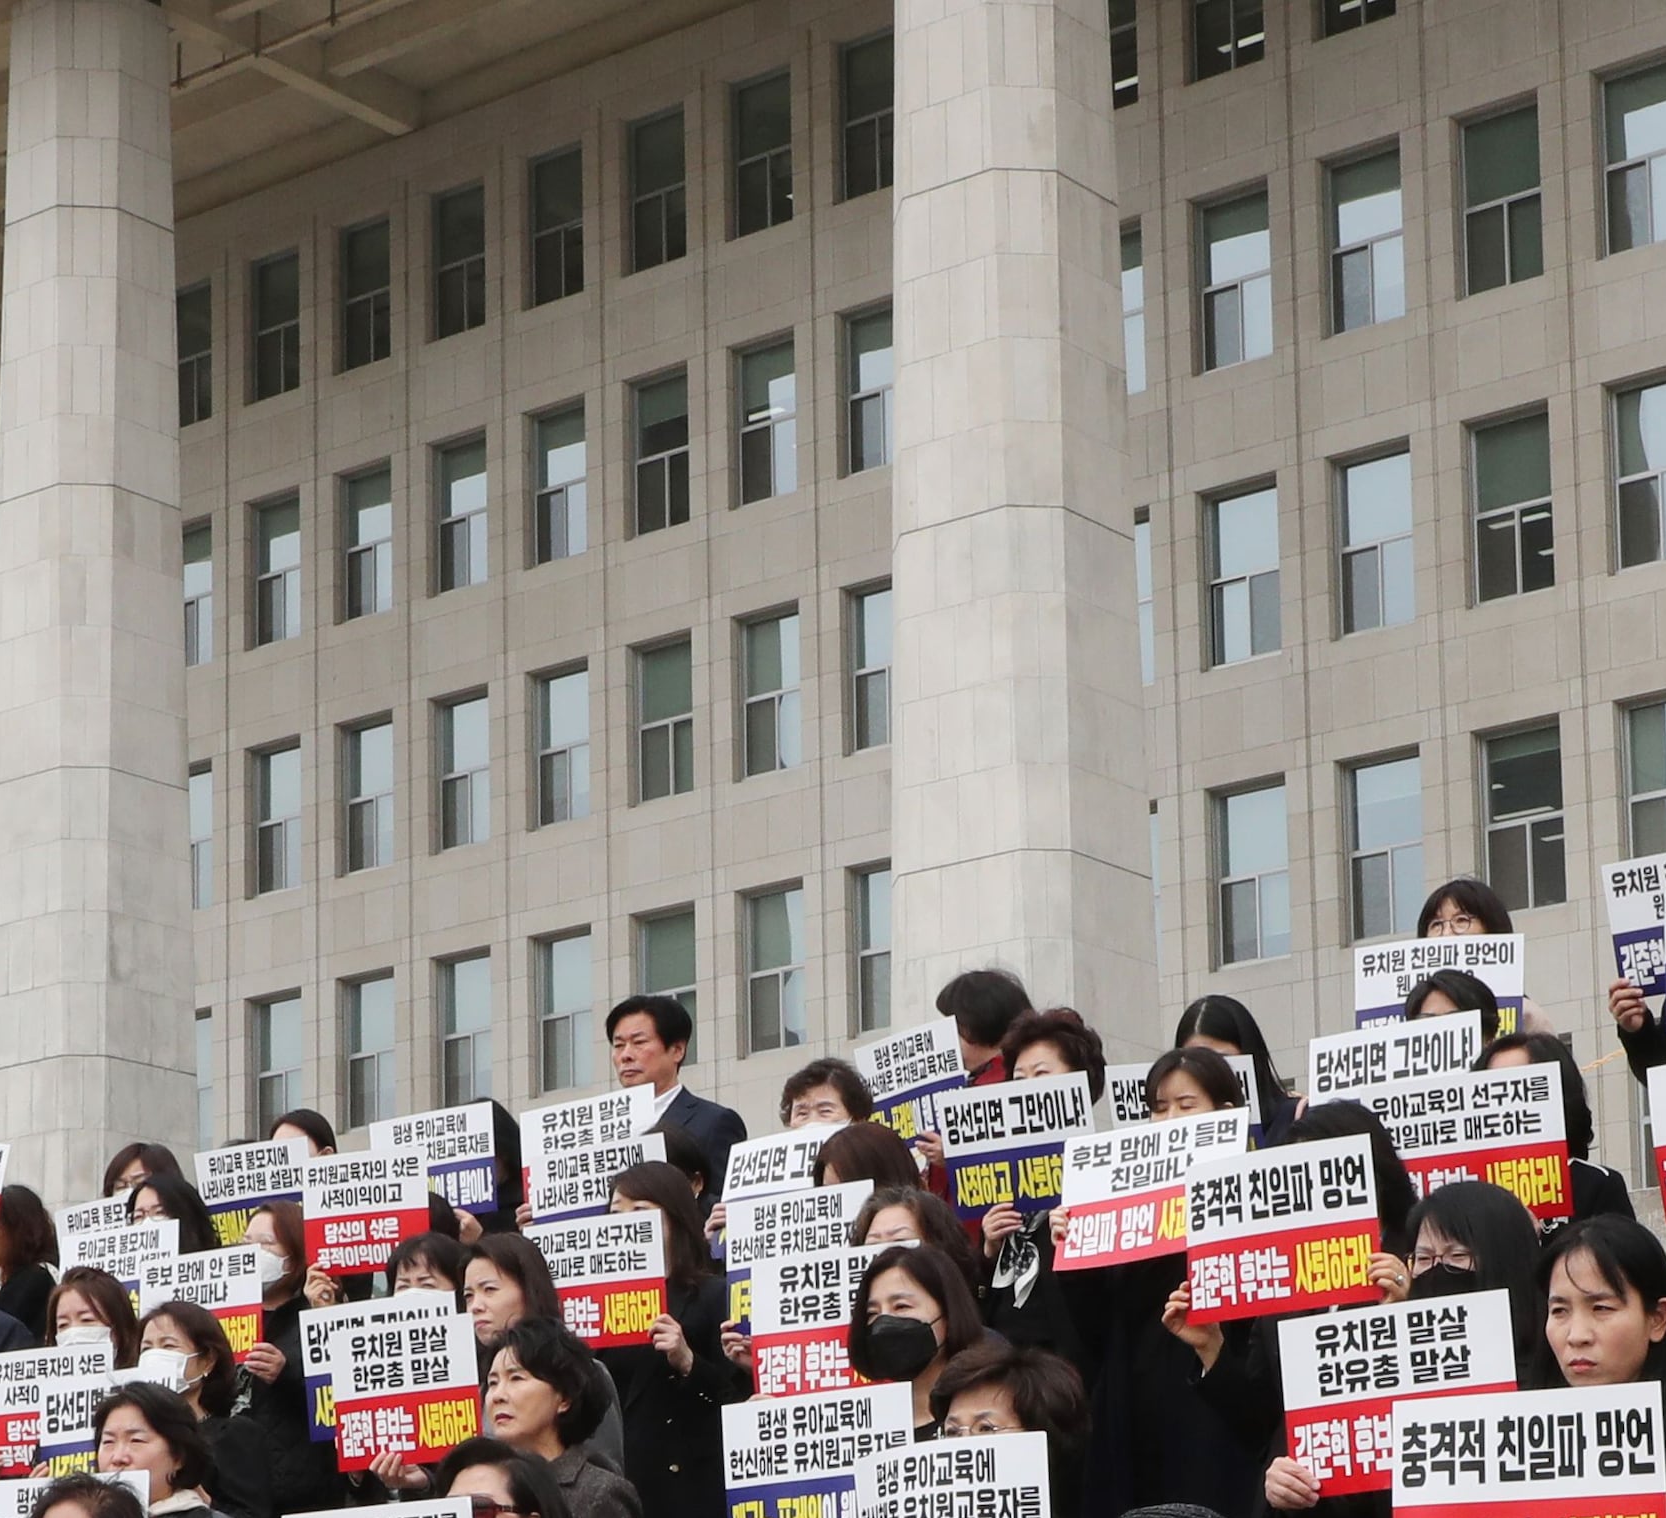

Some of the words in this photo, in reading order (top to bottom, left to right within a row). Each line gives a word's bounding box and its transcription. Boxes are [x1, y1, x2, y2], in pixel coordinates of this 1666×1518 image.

[541, 1108, 593, 1134] 유치원
[598, 1095, 631, 1126] 말살
[944, 1100, 1004, 1147] 당선되면
[1010, 1087, 1087, 1134] 그만이냐!
[208, 1152, 242, 1178] 유아교육
[245, 1146, 289, 1173] 불모지에
[320, 1183, 403, 1208] 사적이익이고
[955, 1160, 1013, 1208] 사죄하고
[1189, 1175, 1243, 1232] 충격적
[1248, 1162, 1313, 1219] 친일파
[1319, 1152, 1369, 1207] 망언
[596, 1219, 654, 1249] 선구자를
[146, 1267, 172, 1289] 후보
[177, 1261, 205, 1284] 맘에
[210, 1258, 224, 1279] 안
[228, 1252, 256, 1276] 들면
[591, 1253, 648, 1276] 매도하는
[779, 1261, 842, 1295] 유치원
[779, 1296, 842, 1325] 한유총
[350, 1334, 402, 1360] 유치원
[408, 1325, 449, 1352] 말살
[1314, 1313, 1397, 1358] 유치원
[1407, 1305, 1469, 1344] 말살
[352, 1363, 404, 1391] 한유총
[409, 1356, 450, 1384] 말살
[1317, 1354, 1401, 1397] 한유총
[1410, 1343, 1471, 1381] 말살
[340, 1408, 375, 1457] 김준혁
[374, 1406, 415, 1452] 후보는
[417, 1396, 477, 1446] 사퇴하라!
[758, 1410, 787, 1441] 평생
[793, 1397, 872, 1436] 유아교육에
[729, 1444, 789, 1481] 헌신해온
[1401, 1417, 1486, 1488] 충격적
[1497, 1412, 1587, 1482] 친일파
[1596, 1407, 1656, 1477] 망언
[877, 1460, 899, 1496] 평생
[903, 1449, 996, 1495] 유아교육에
